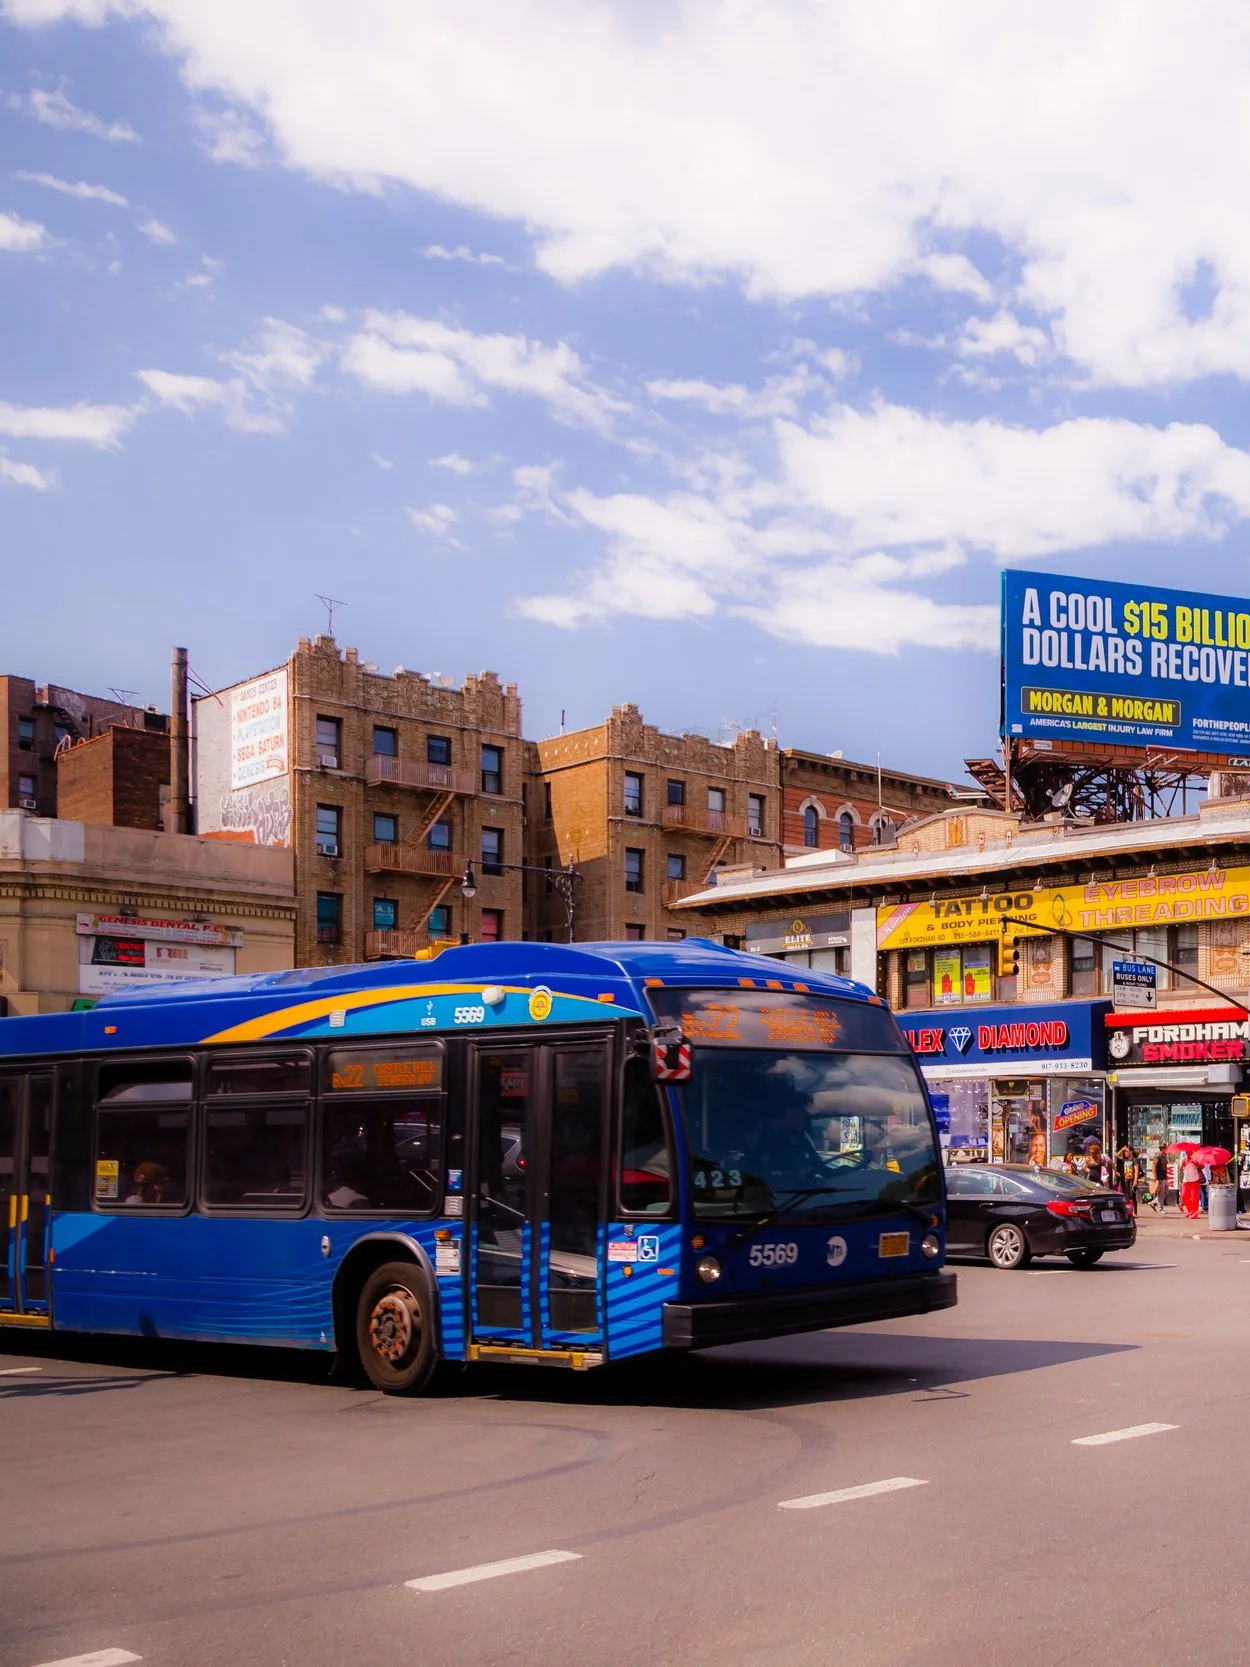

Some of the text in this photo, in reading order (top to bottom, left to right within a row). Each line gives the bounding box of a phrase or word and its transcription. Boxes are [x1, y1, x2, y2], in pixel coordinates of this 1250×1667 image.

[1022, 588, 1041, 626] A
[1050, 591, 1118, 634] COOL
[1123, 600, 1168, 640] $15
[1022, 628, 1143, 676] DOLLARS
[237, 695, 281, 723] NINTENDO 64
[1029, 691, 1173, 722] MORGAN & MORGAN
[1029, 718, 1071, 729] AMERICA'S
[1072, 721, 1107, 731] LARGEST
[1108, 724, 1135, 734] INJURY
[1136, 727, 1153, 735] LAW
[1154, 728, 1173, 737] FIRM
[237, 733, 284, 762] SEGA SATURN
[1084, 872, 1226, 904] EYEBROW
[931, 893, 1034, 919] TATTOO
[1078, 894, 1249, 927] THREADING
[99, 915, 147, 926] GENESIS
[151, 920, 200, 932] DENTAL,
[927, 924, 936, 932] &
[941, 919, 974, 931] BODY
[785, 933, 811, 944] ELITE
[1116, 973, 1136, 981] BUSES
[1138, 966, 1155, 974] LANE
[421, 1017, 436, 1026] USB
[454, 1006, 485, 1024] 5569
[978, 1020, 1067, 1050] DIAMOND
[1133, 1022, 1248, 1043] FORDHAM
[1142, 1040, 1244, 1061] SMOKER
[1041, 1062, 1088, 1070] 917-933-8230
[1059, 1108, 1094, 1127] OPENING
[749, 1242, 799, 1267] 5569
